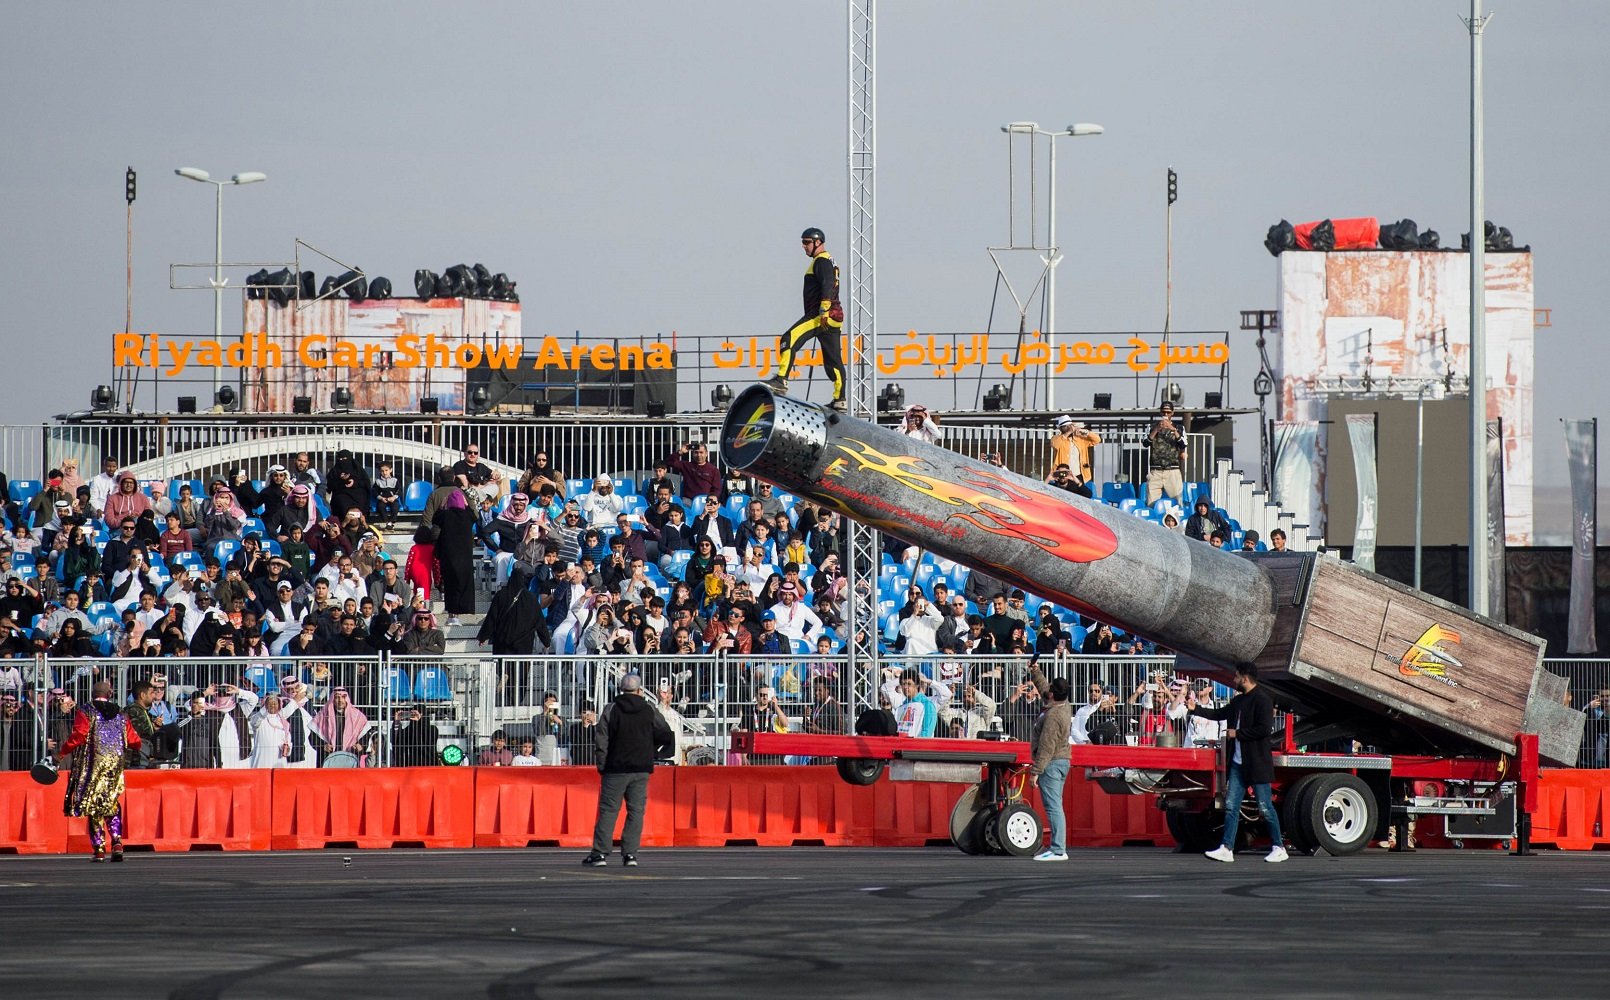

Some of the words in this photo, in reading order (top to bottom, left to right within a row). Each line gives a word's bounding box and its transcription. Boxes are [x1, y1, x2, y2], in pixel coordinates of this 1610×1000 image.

[113, 332, 283, 376] Riyadh
[298, 333, 381, 369] Car
[394, 333, 523, 370] Show
[534, 336, 673, 370] Arena
[877, 330, 988, 376] الرياض
[1001, 330, 1116, 375] معرض
[1127, 336, 1230, 373] مسرح
